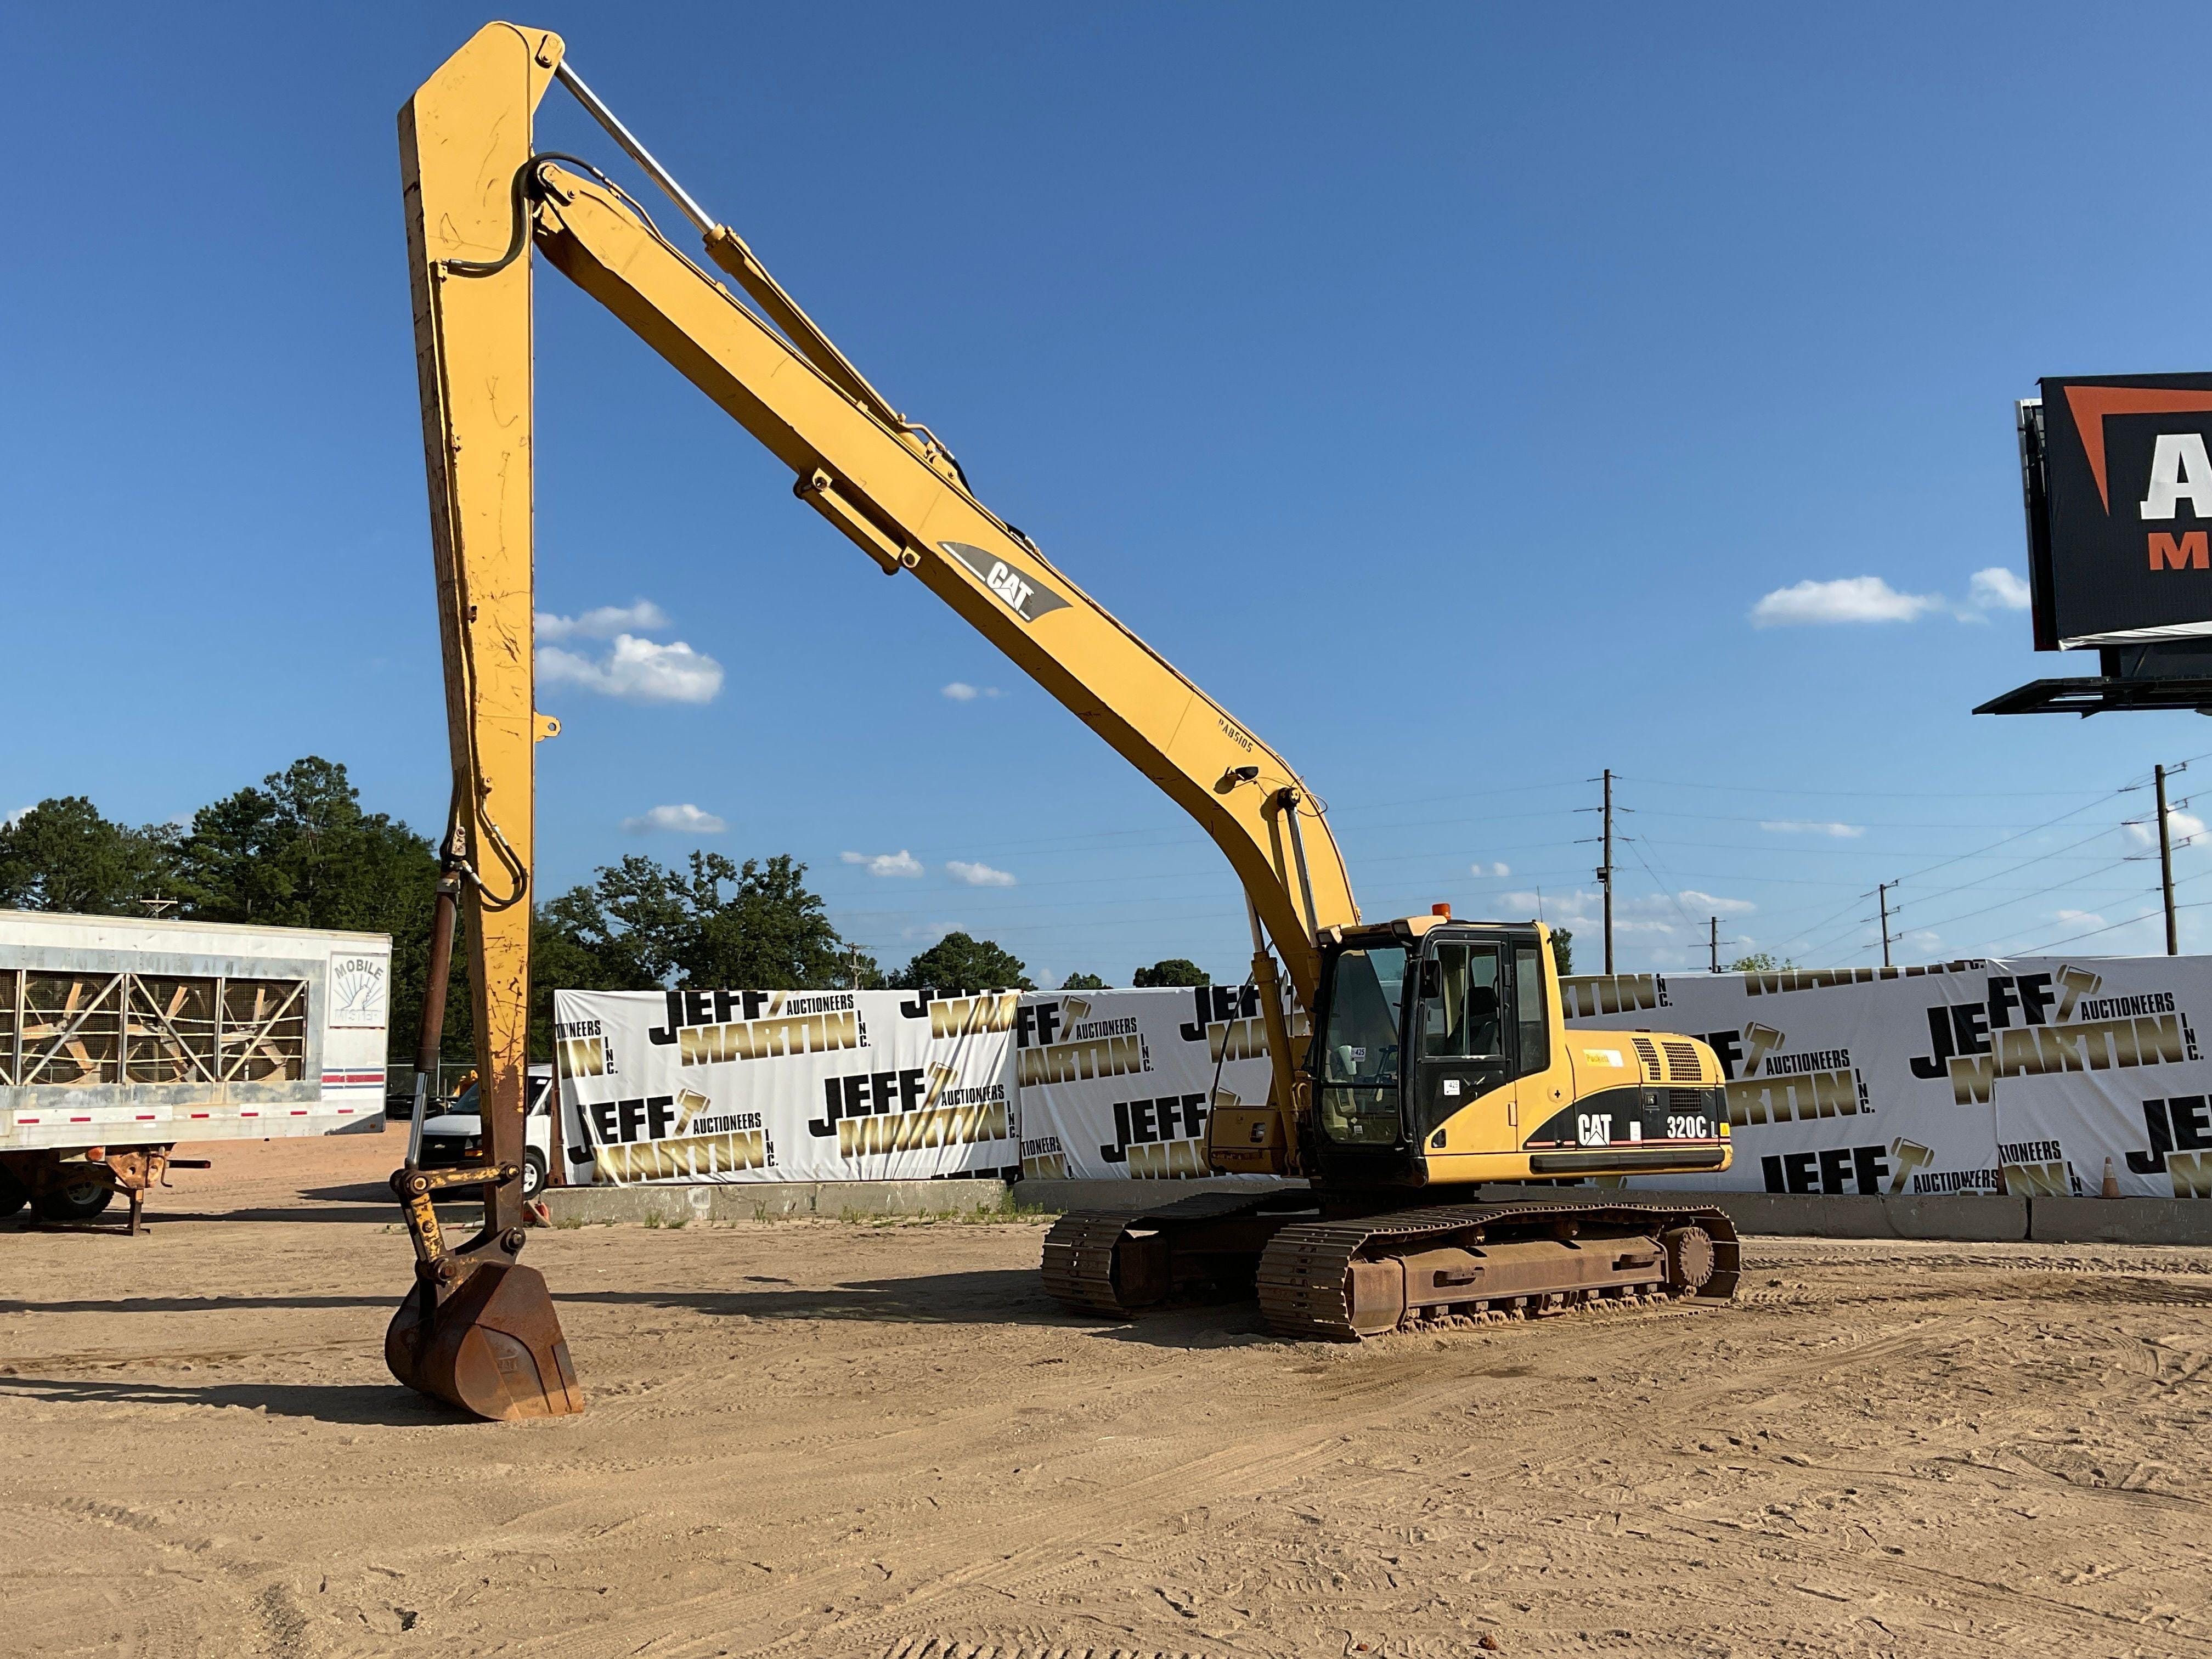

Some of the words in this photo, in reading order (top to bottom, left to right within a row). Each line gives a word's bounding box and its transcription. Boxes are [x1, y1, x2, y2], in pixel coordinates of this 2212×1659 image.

[2148, 532, 2210, 570] M
[988, 561, 1034, 611] CAT
[335, 959, 383, 980] MOBILE
[648, 991, 769, 1045] JEFF
[787, 994, 854, 1015] AUCTIONEERS
[1180, 986, 1262, 1041] JEF
[2081, 992, 2175, 1021] AUCTIONEERS
[680, 1011, 856, 1066] MARTIN
[858, 1010, 871, 1047] INC.
[1076, 1017, 1137, 1040] AUCTIONEERS
[2181, 1013, 2204, 1060] INC.
[605, 1036, 618, 1074] INC.
[1018, 1035, 1141, 1087] ARTIN
[1141, 1034, 1154, 1072] INC.
[1766, 1049, 1850, 1075] AUCTIONEERS
[809, 1069, 926, 1137] JEFF
[941, 1084, 1005, 1107] AUCTIONEERS
[1855, 1069, 1875, 1114] INC.
[568, 1096, 674, 1165] JEFF
[693, 1113, 761, 1135] AUCTIONEERS
[838, 1102, 1007, 1158] MARTIN
[1007, 1101, 1020, 1138] INC.
[1101, 1093, 1208, 1163] JEFF
[1578, 1114, 1612, 1146] CAT
[1667, 1116, 1707, 1138] 320C
[1711, 1121, 1718, 1138] L
[2125, 1094, 2212, 1174] JE
[592, 1130, 764, 1182] MARTIN
[765, 1129, 778, 1167] INC.
[1022, 1136, 1062, 1156] TIONEERS
[1998, 1141, 2061, 1164] TIONEERS
[1914, 1169, 1999, 1193] AUCTIONEERS
[2067, 1161, 2083, 1197] IN
